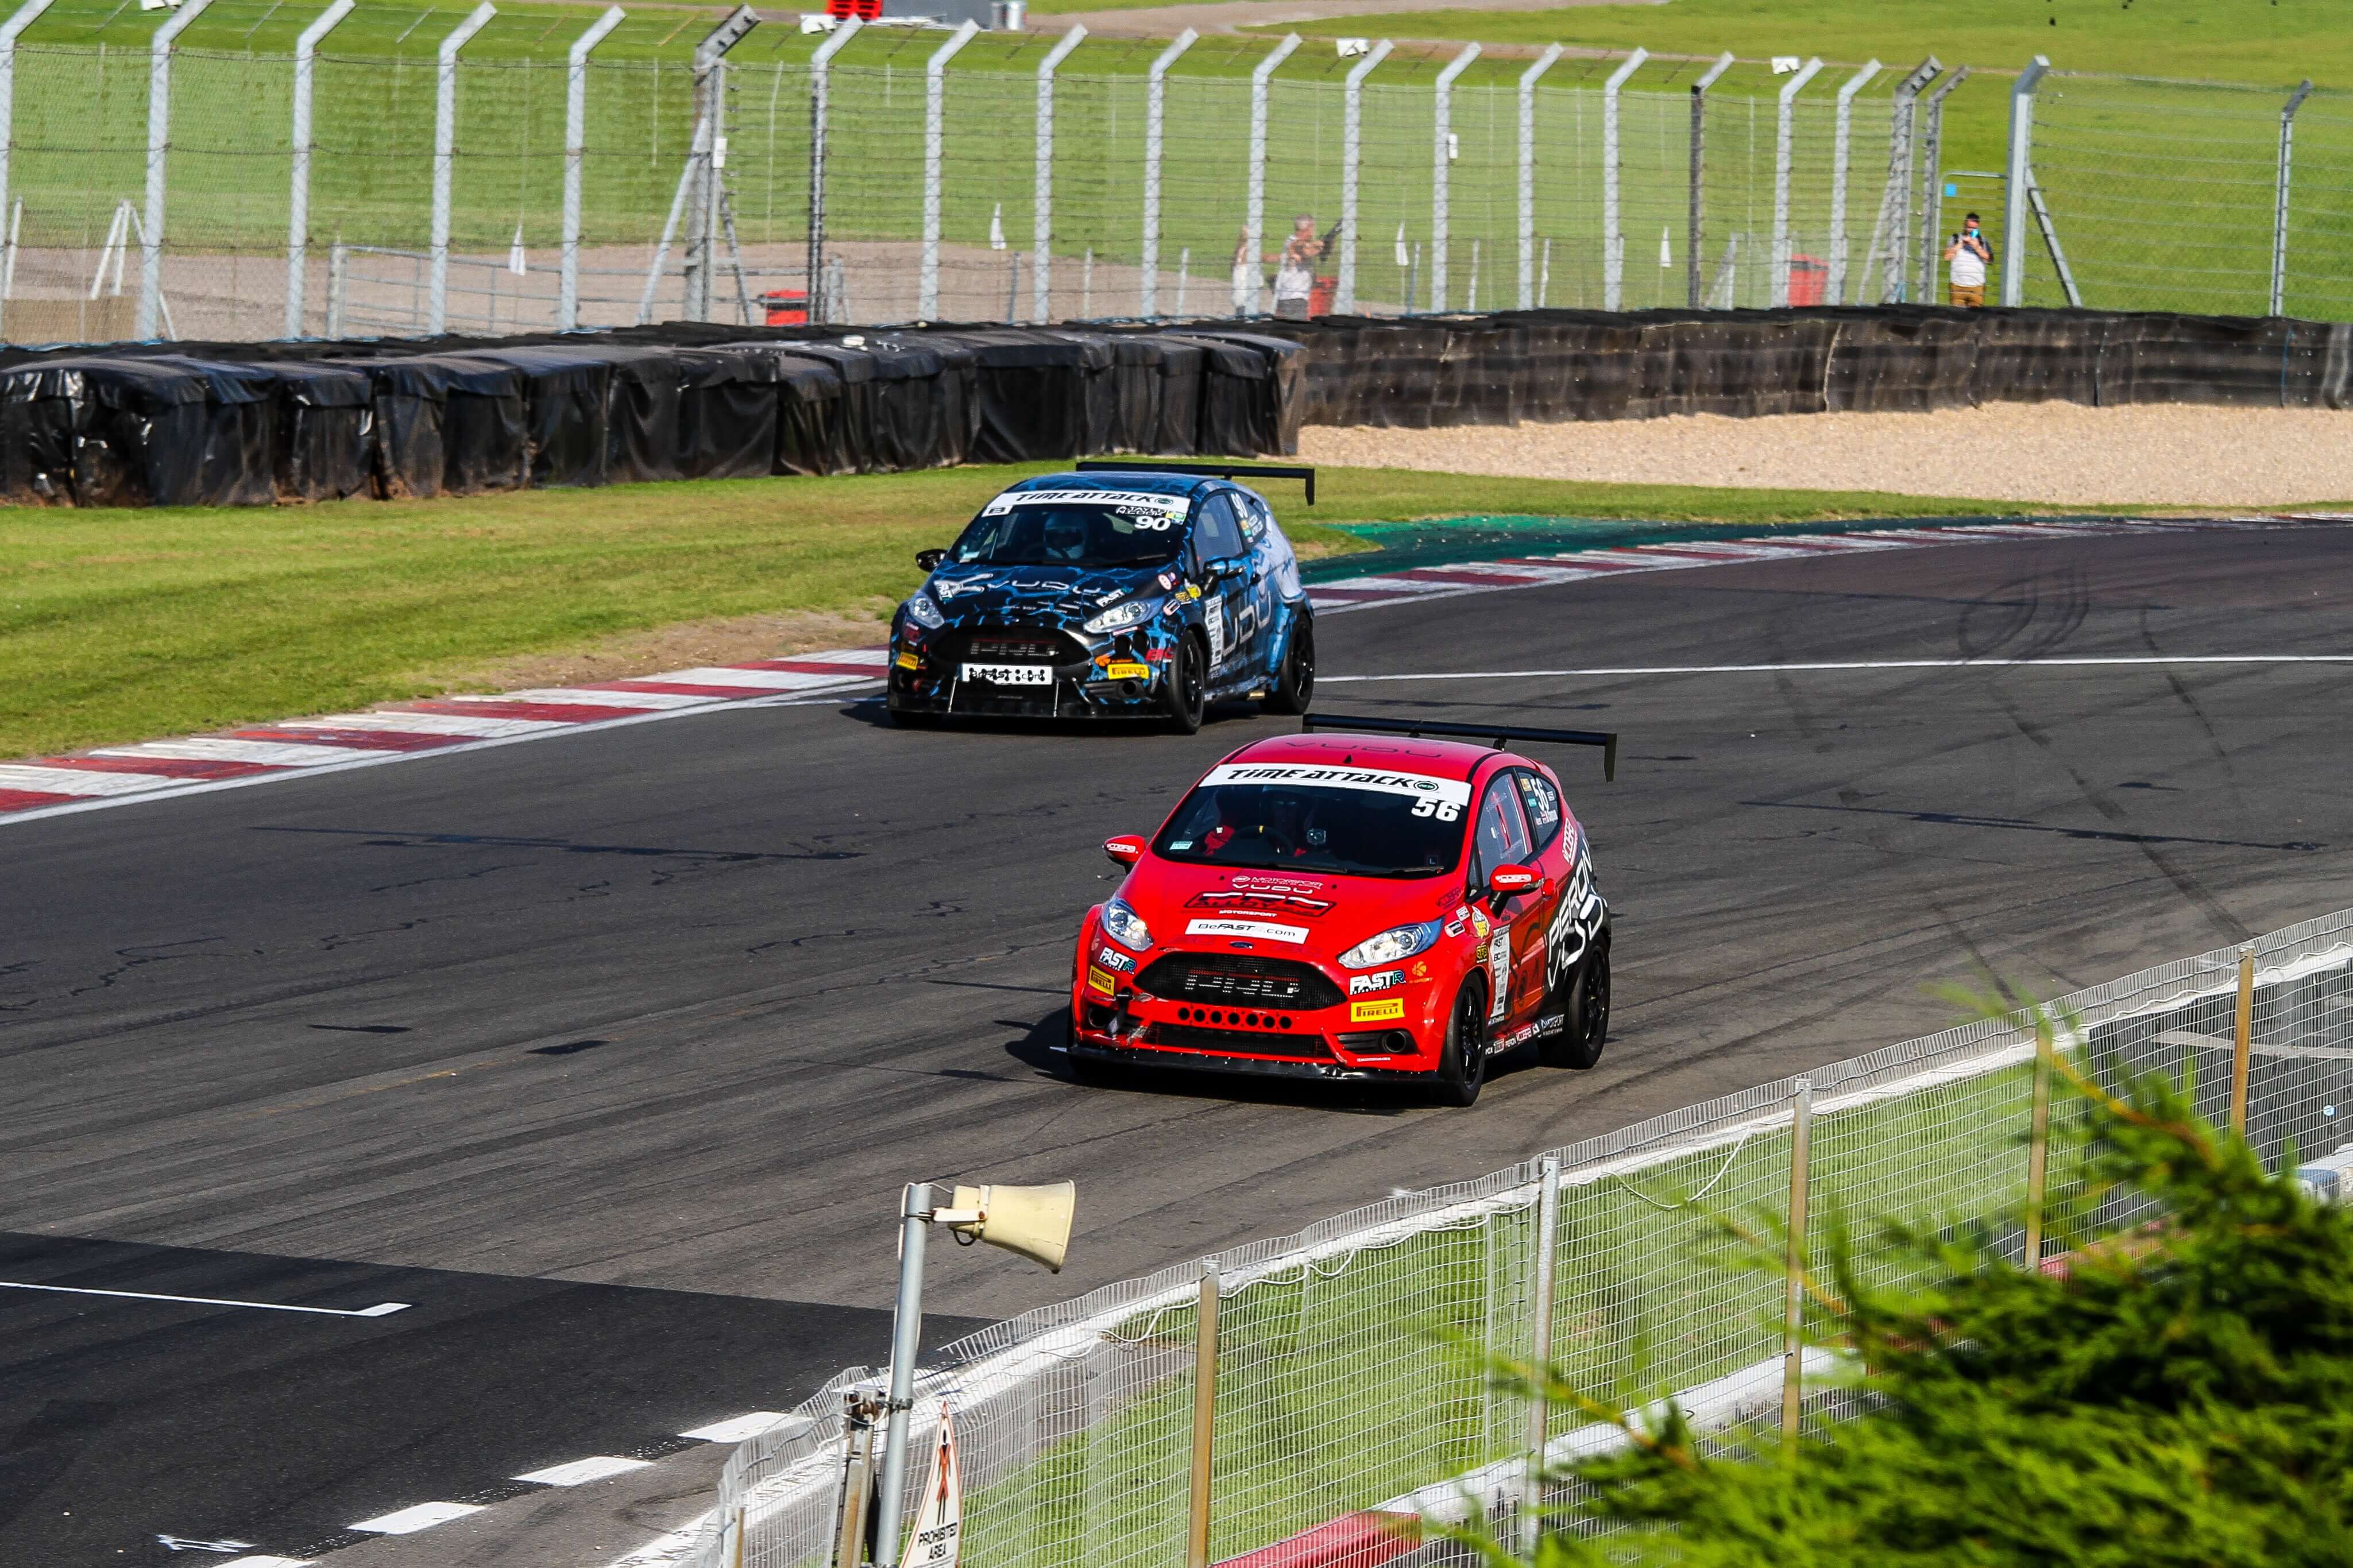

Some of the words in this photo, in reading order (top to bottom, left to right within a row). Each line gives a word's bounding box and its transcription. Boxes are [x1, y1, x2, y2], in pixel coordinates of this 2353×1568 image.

[1015, 492, 1073, 501] TIME
[1074, 492, 1153, 502] ATTACK
[1134, 516, 1170, 531] 90
[1228, 769, 1305, 779] TIME
[1300, 769, 1415, 788] ATTACK
[1530, 778, 1550, 811] 56
[1411, 796, 1461, 822] 56
[1232, 884, 1313, 895] VUDU
[1356, 1002, 1398, 1017] PIRELLI
